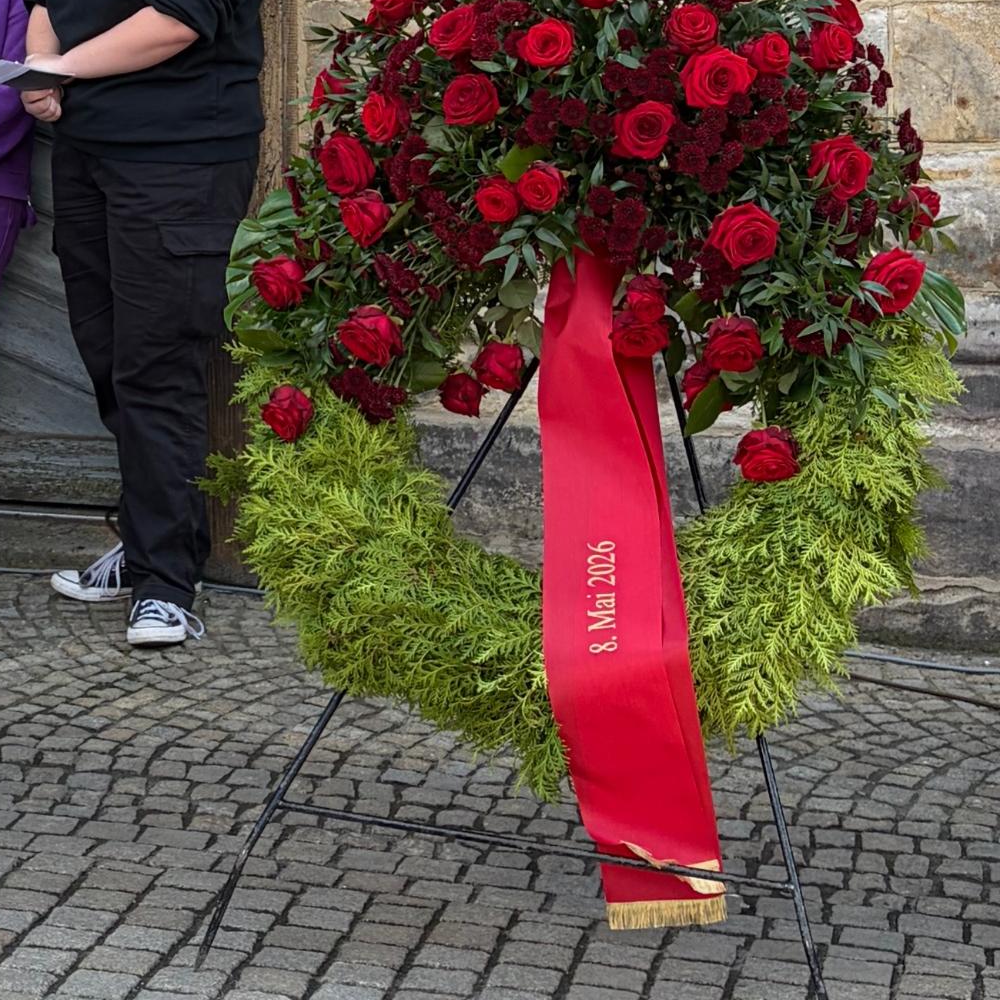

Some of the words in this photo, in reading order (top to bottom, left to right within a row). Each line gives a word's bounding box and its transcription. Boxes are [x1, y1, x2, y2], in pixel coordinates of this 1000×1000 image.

[587, 541, 616, 588] 2026
[587, 592, 617, 632] Mai
[589, 636, 618, 654] 8.
